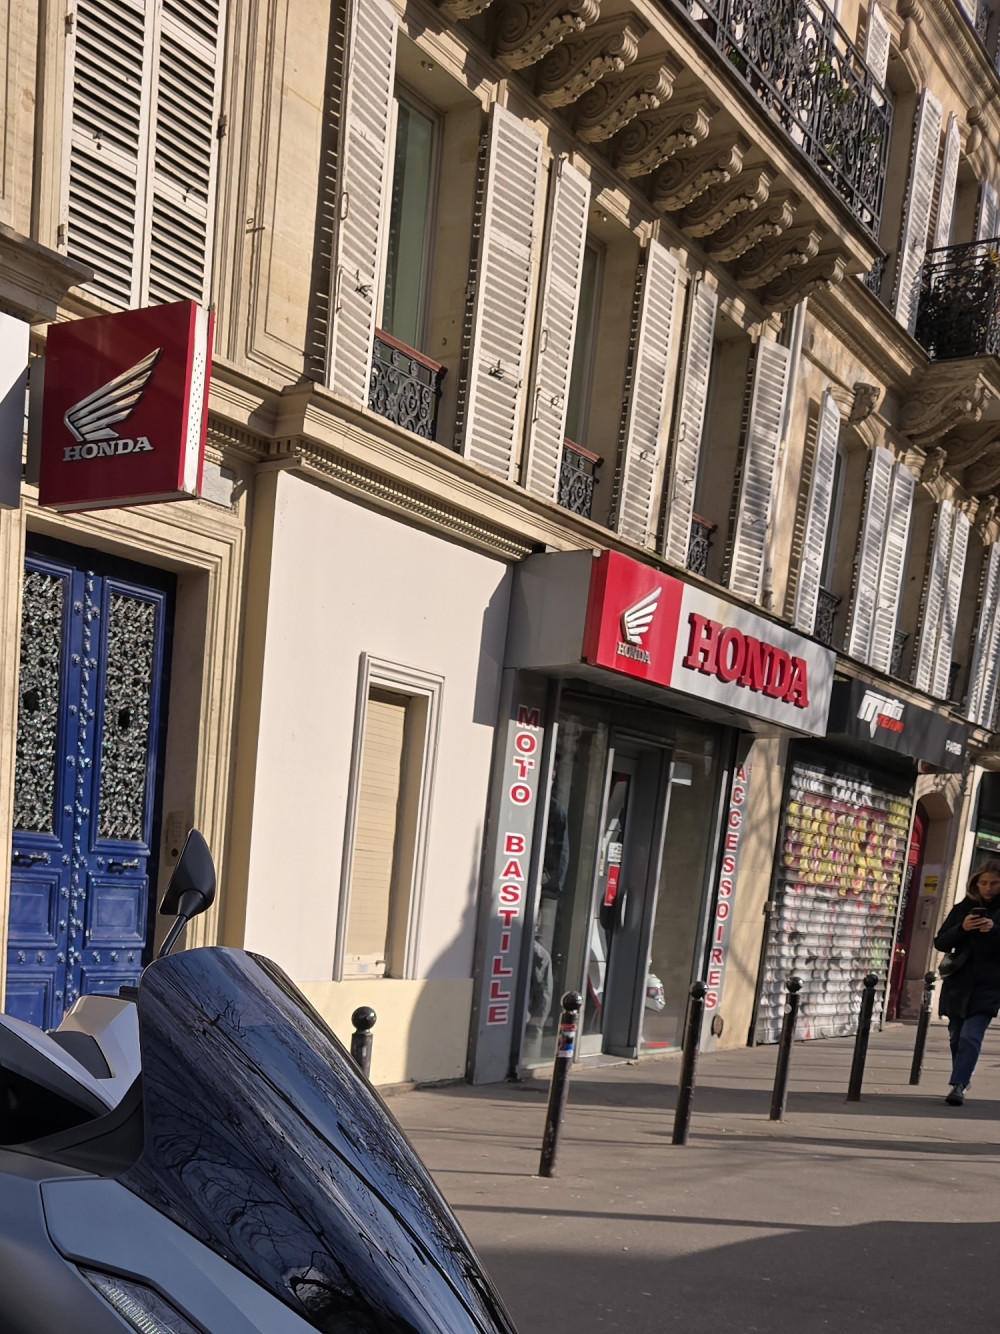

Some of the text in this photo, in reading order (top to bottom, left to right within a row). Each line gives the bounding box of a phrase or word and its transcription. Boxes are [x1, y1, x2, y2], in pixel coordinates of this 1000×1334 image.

[63, 437, 154, 461] HONDA
[616, 641, 650, 664] HONDA
[682, 612, 809, 708] HONDA
[509, 706, 540, 805] MOTO
[876, 713, 904, 733] TEAM
[487, 832, 526, 1025] BASTILLE
[704, 763, 747, 1011] ACCESSOIRES
